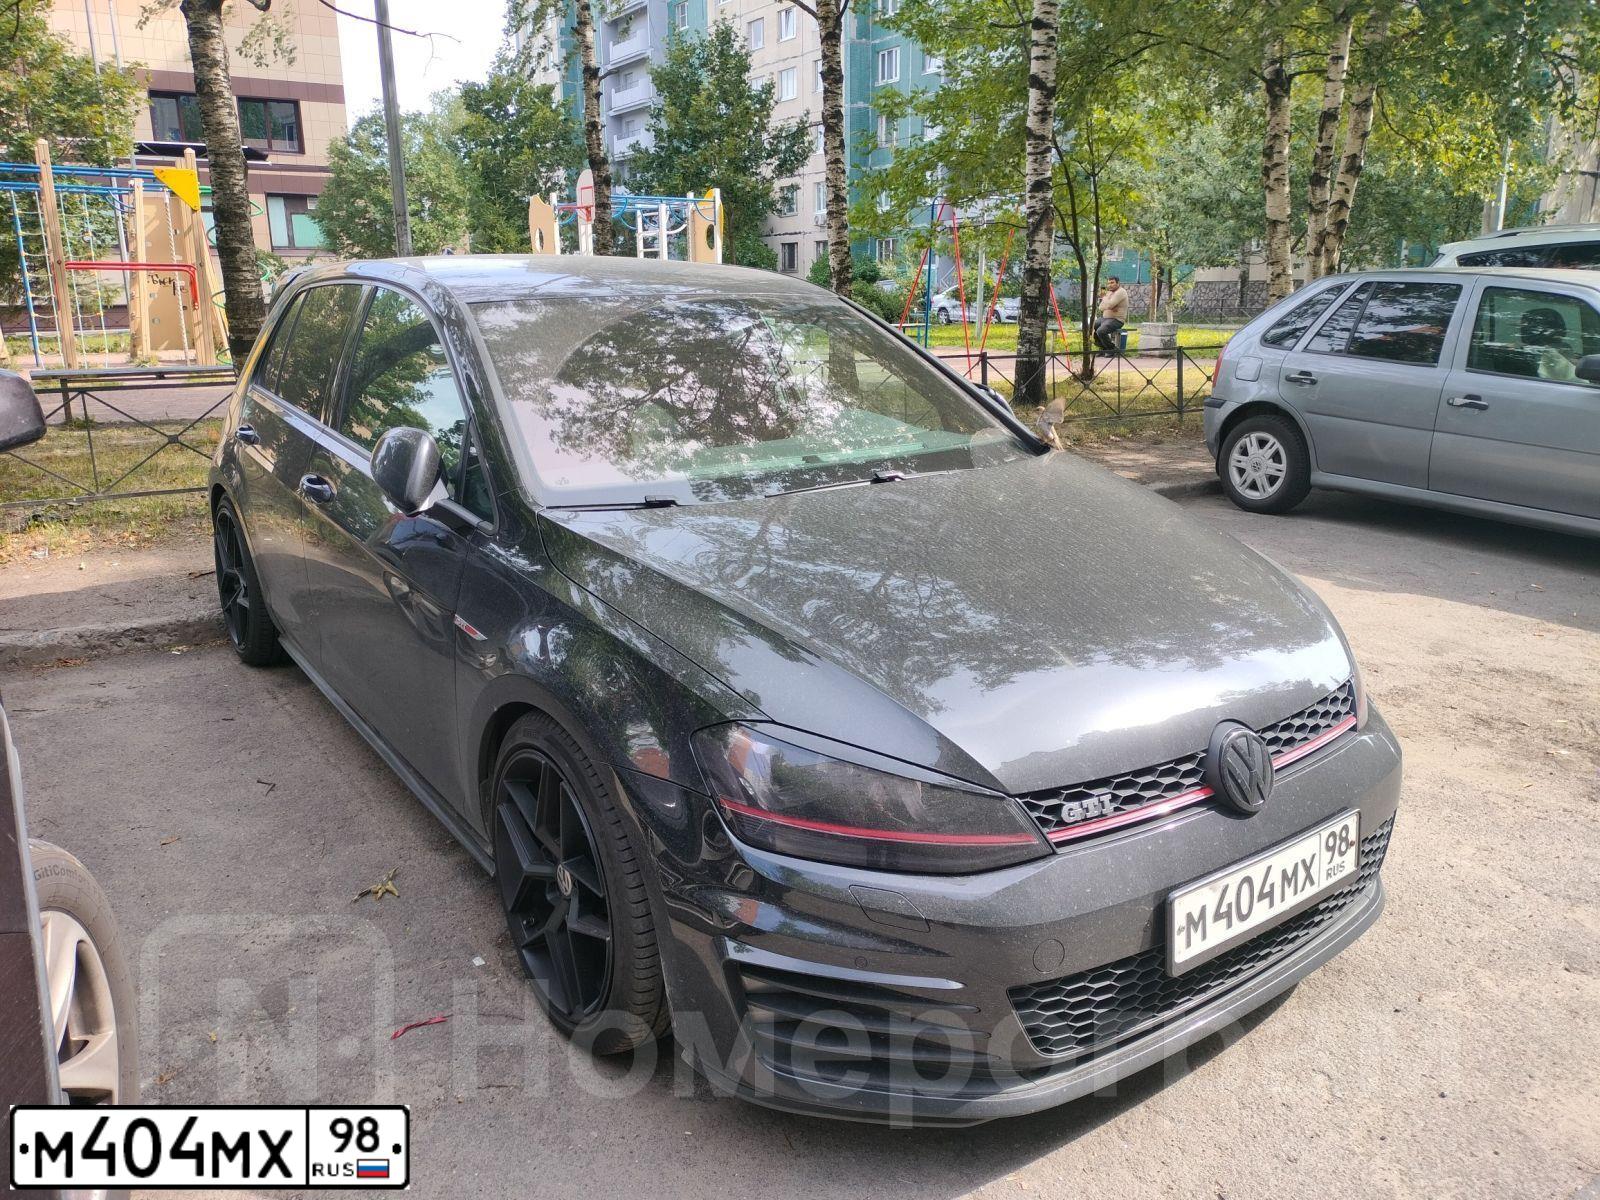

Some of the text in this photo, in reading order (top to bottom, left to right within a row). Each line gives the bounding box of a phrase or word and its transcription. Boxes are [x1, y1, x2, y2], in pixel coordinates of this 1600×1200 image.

[1060, 794, 1114, 824] GTI
[1325, 860, 1346, 881] RUS
[1185, 824, 1350, 950] М404МХ 98
